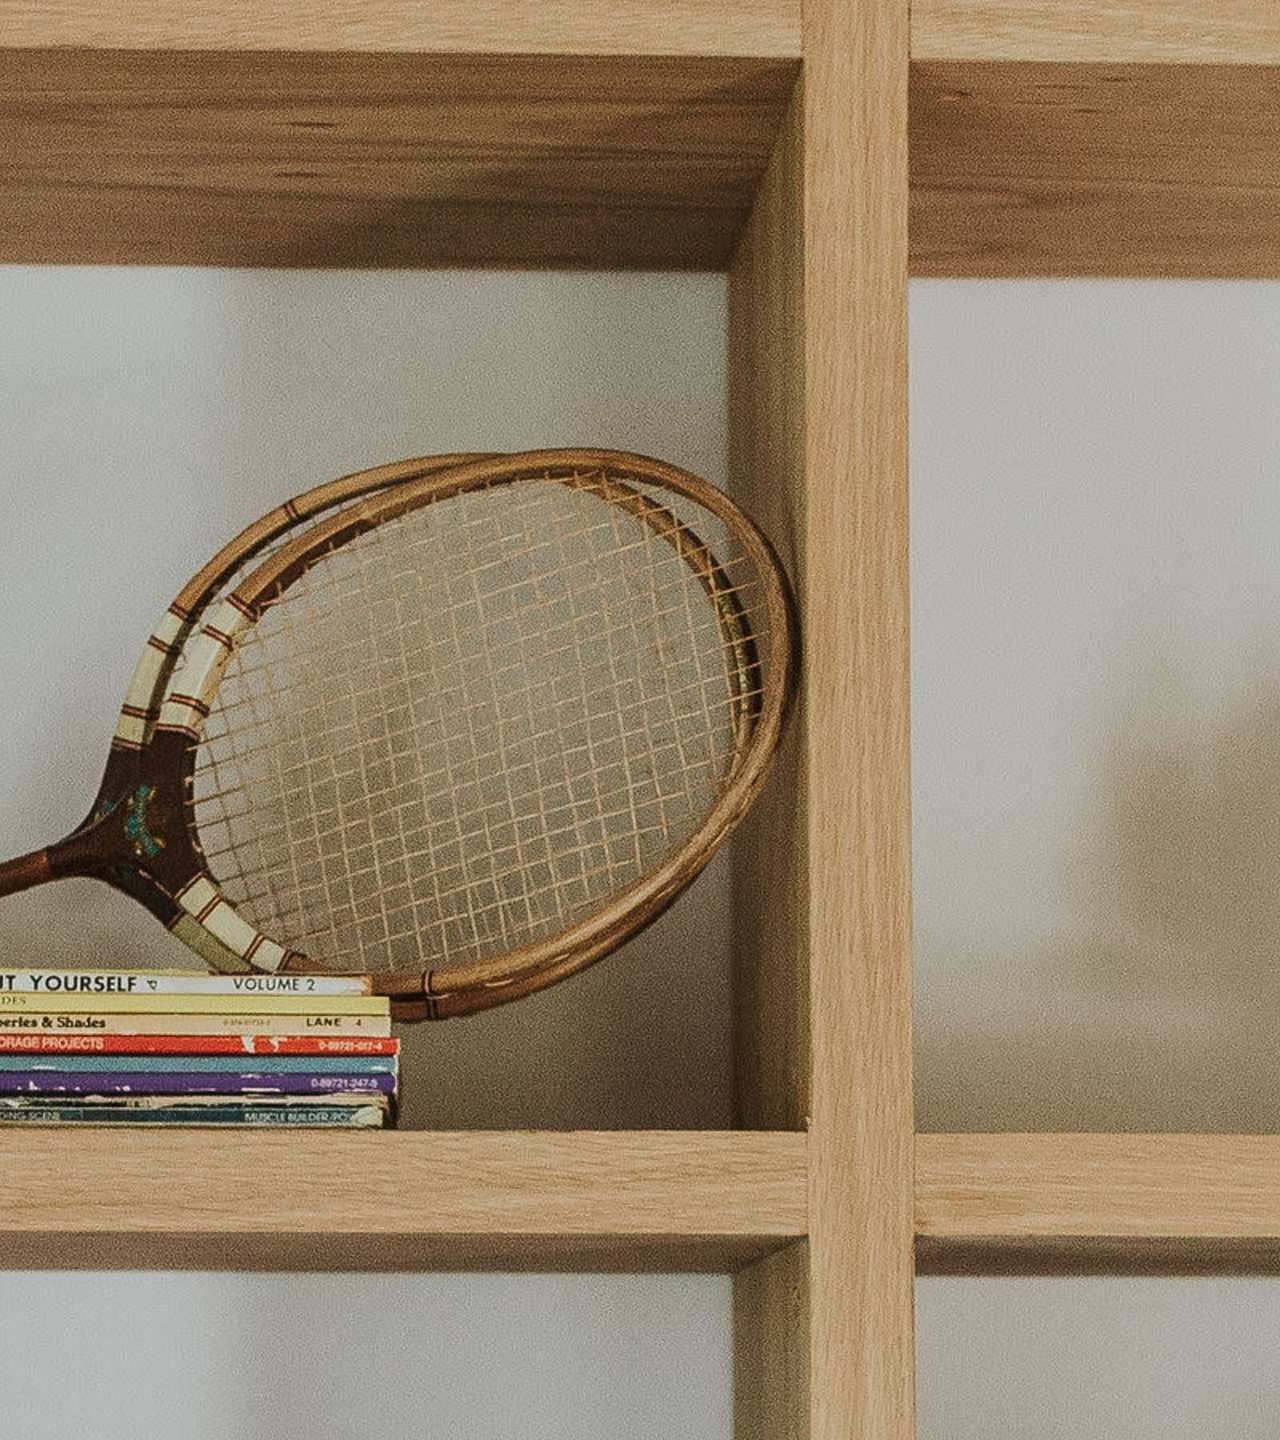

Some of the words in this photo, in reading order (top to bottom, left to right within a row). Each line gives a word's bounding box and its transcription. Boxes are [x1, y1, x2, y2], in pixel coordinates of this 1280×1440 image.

[0, 975, 16, 992] IT
[30, 976, 137, 992] YOURSELF
[233, 977, 300, 992] VOLUME
[306, 978, 316, 992] 2
[42, 1017, 53, 1028] &
[56, 1016, 106, 1029] Shades
[306, 1017, 342, 1027] LANE
[42, 1037, 104, 1050] PROJECTS
